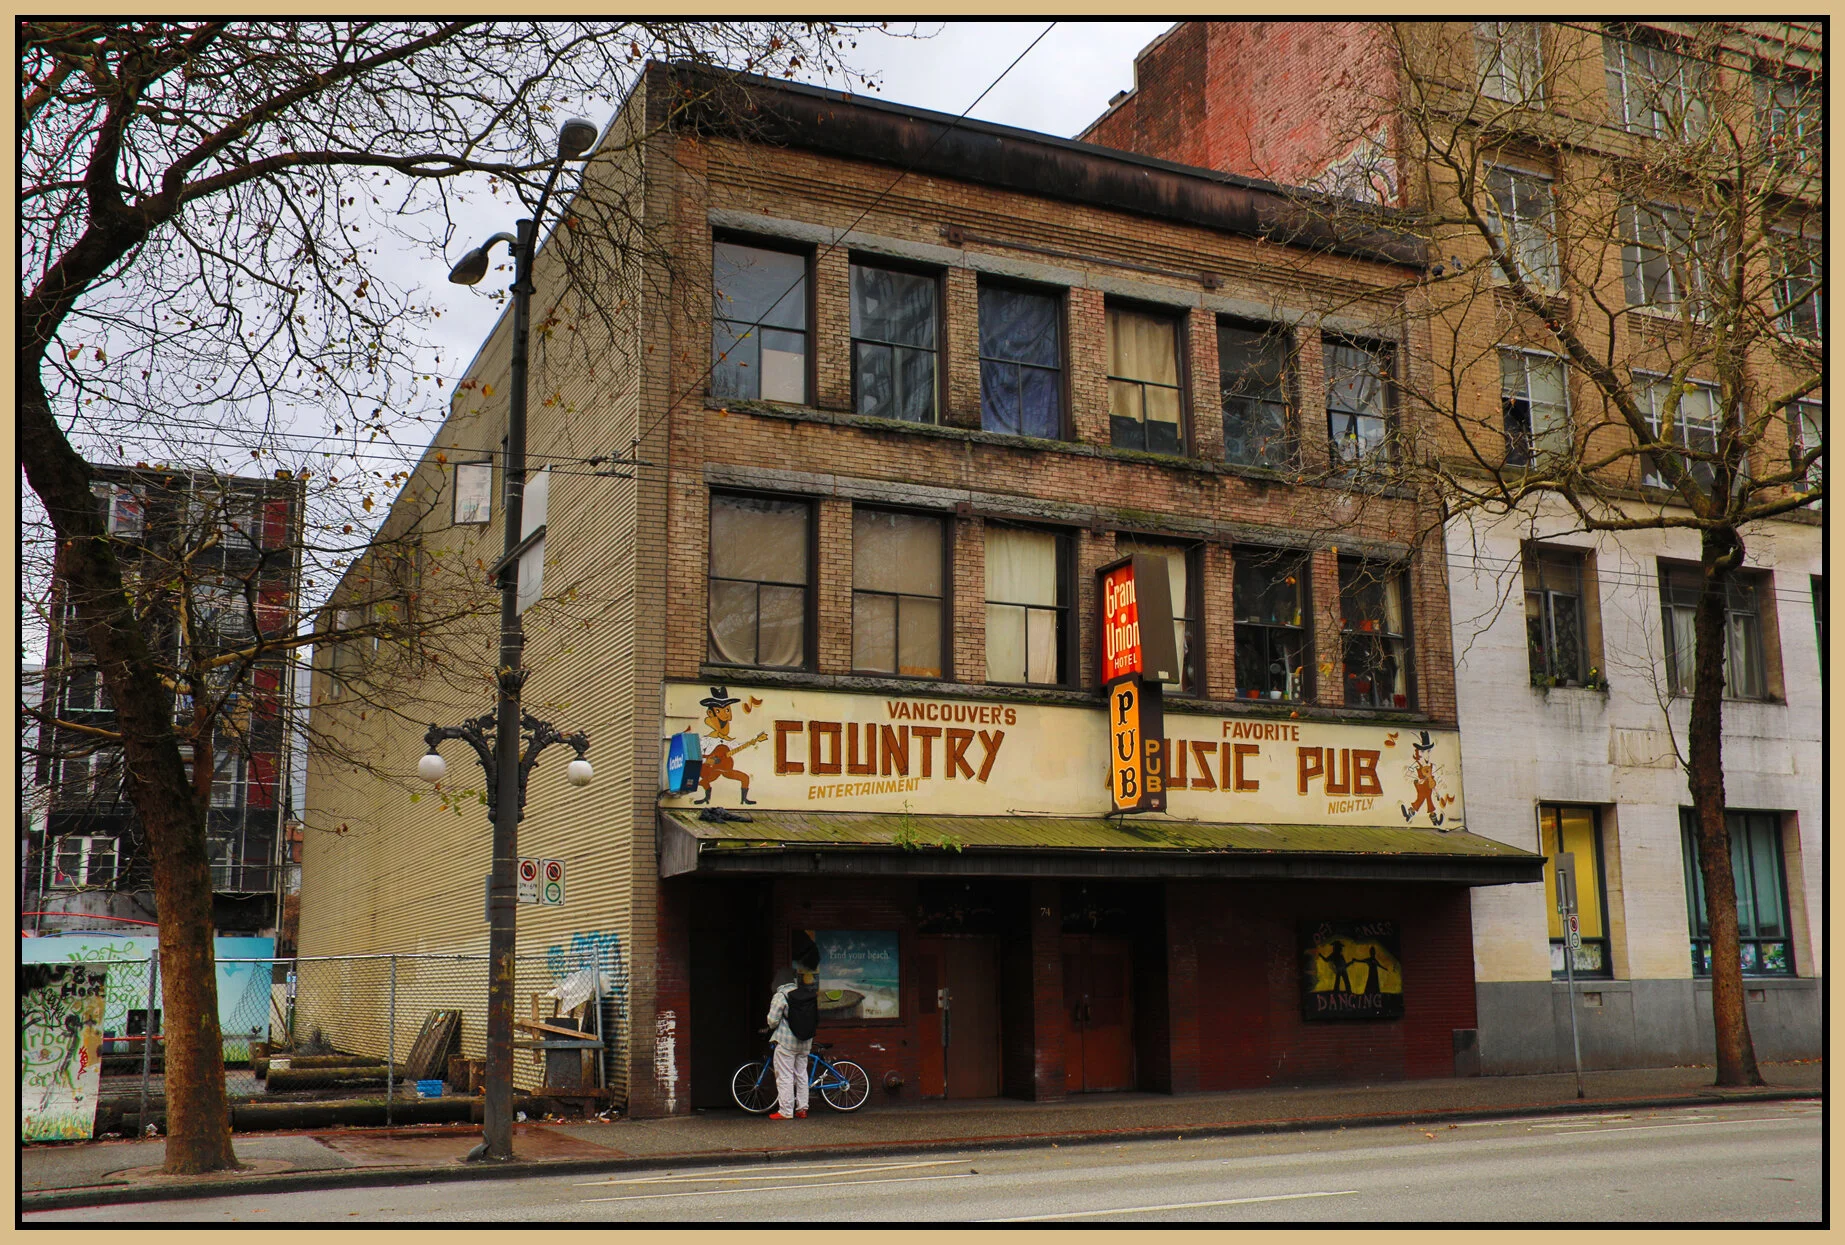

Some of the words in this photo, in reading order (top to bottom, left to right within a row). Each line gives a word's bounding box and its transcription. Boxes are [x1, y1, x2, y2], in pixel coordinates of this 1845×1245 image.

[1106, 620, 1140, 661] Union
[1114, 652, 1138, 669] HOTEL
[887, 701, 1016, 726] VANCOUVER'S
[1222, 720, 1300, 742] FAVORITE
[773, 719, 1006, 784] COUNTRY
[1115, 690, 1137, 799] PUB
[1105, 738, 1261, 793] USIC
[1144, 739, 1163, 793] PUB
[1297, 745, 1384, 798] PUB
[807, 776, 921, 800] ENTERTAINMENT
[1327, 797, 1375, 815] NIGHTLY
[848, 952, 866, 961] your
[1316, 993, 1384, 1011] DANCING
